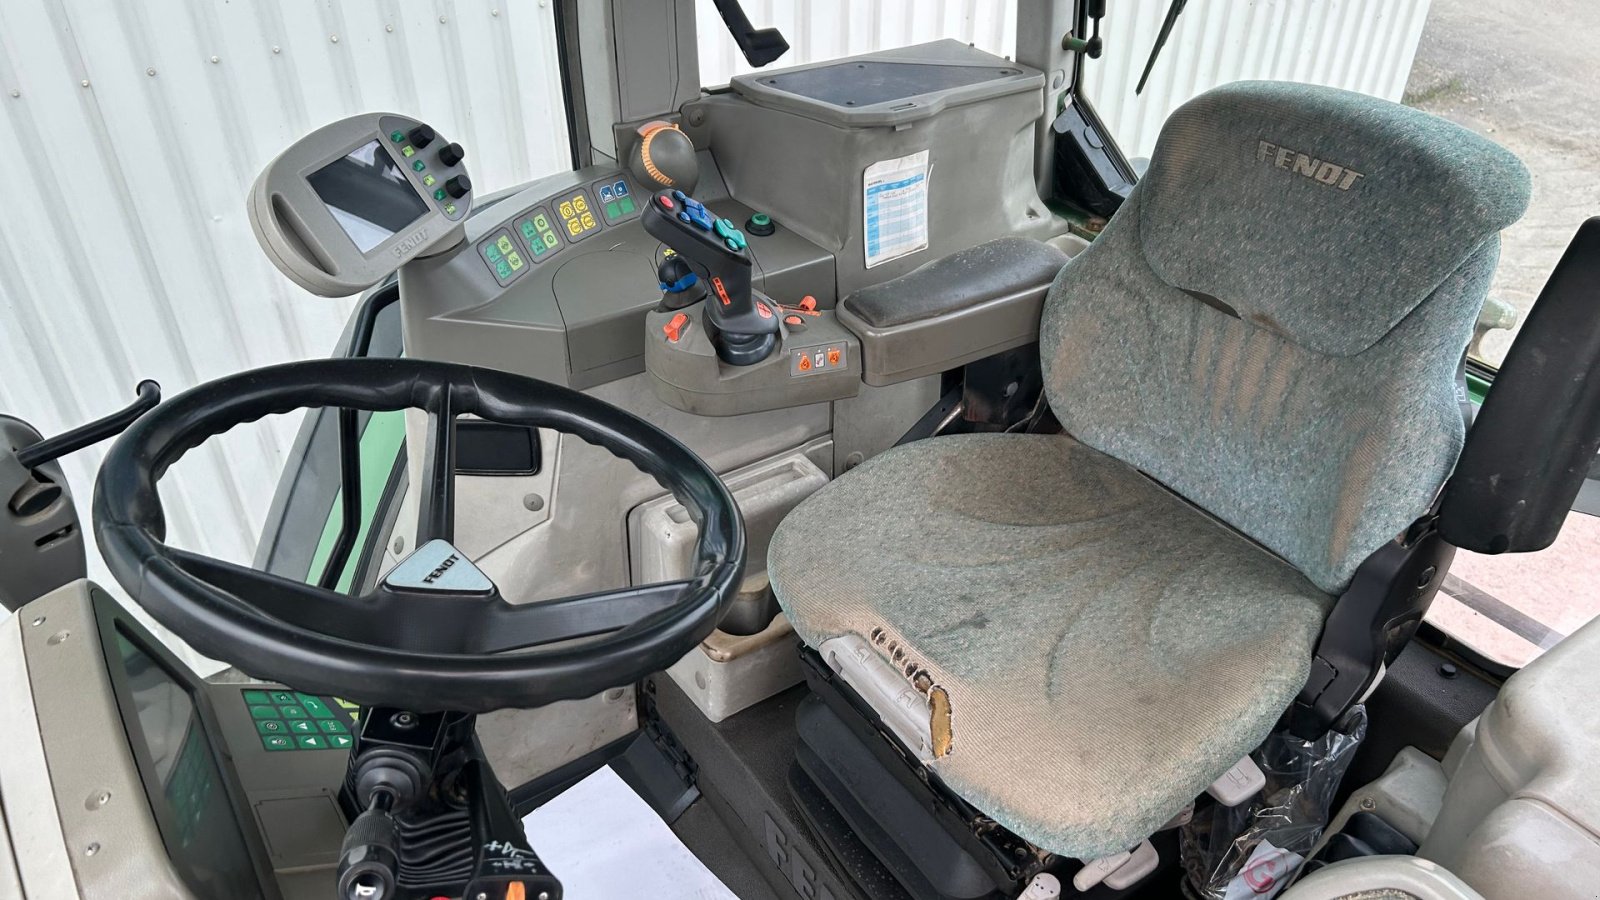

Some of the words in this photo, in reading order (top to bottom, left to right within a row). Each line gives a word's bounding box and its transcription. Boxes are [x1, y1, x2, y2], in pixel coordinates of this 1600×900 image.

[1257, 140, 1365, 191] FENDT
[394, 229, 428, 257] FENDT
[423, 553, 460, 584] FENDT
